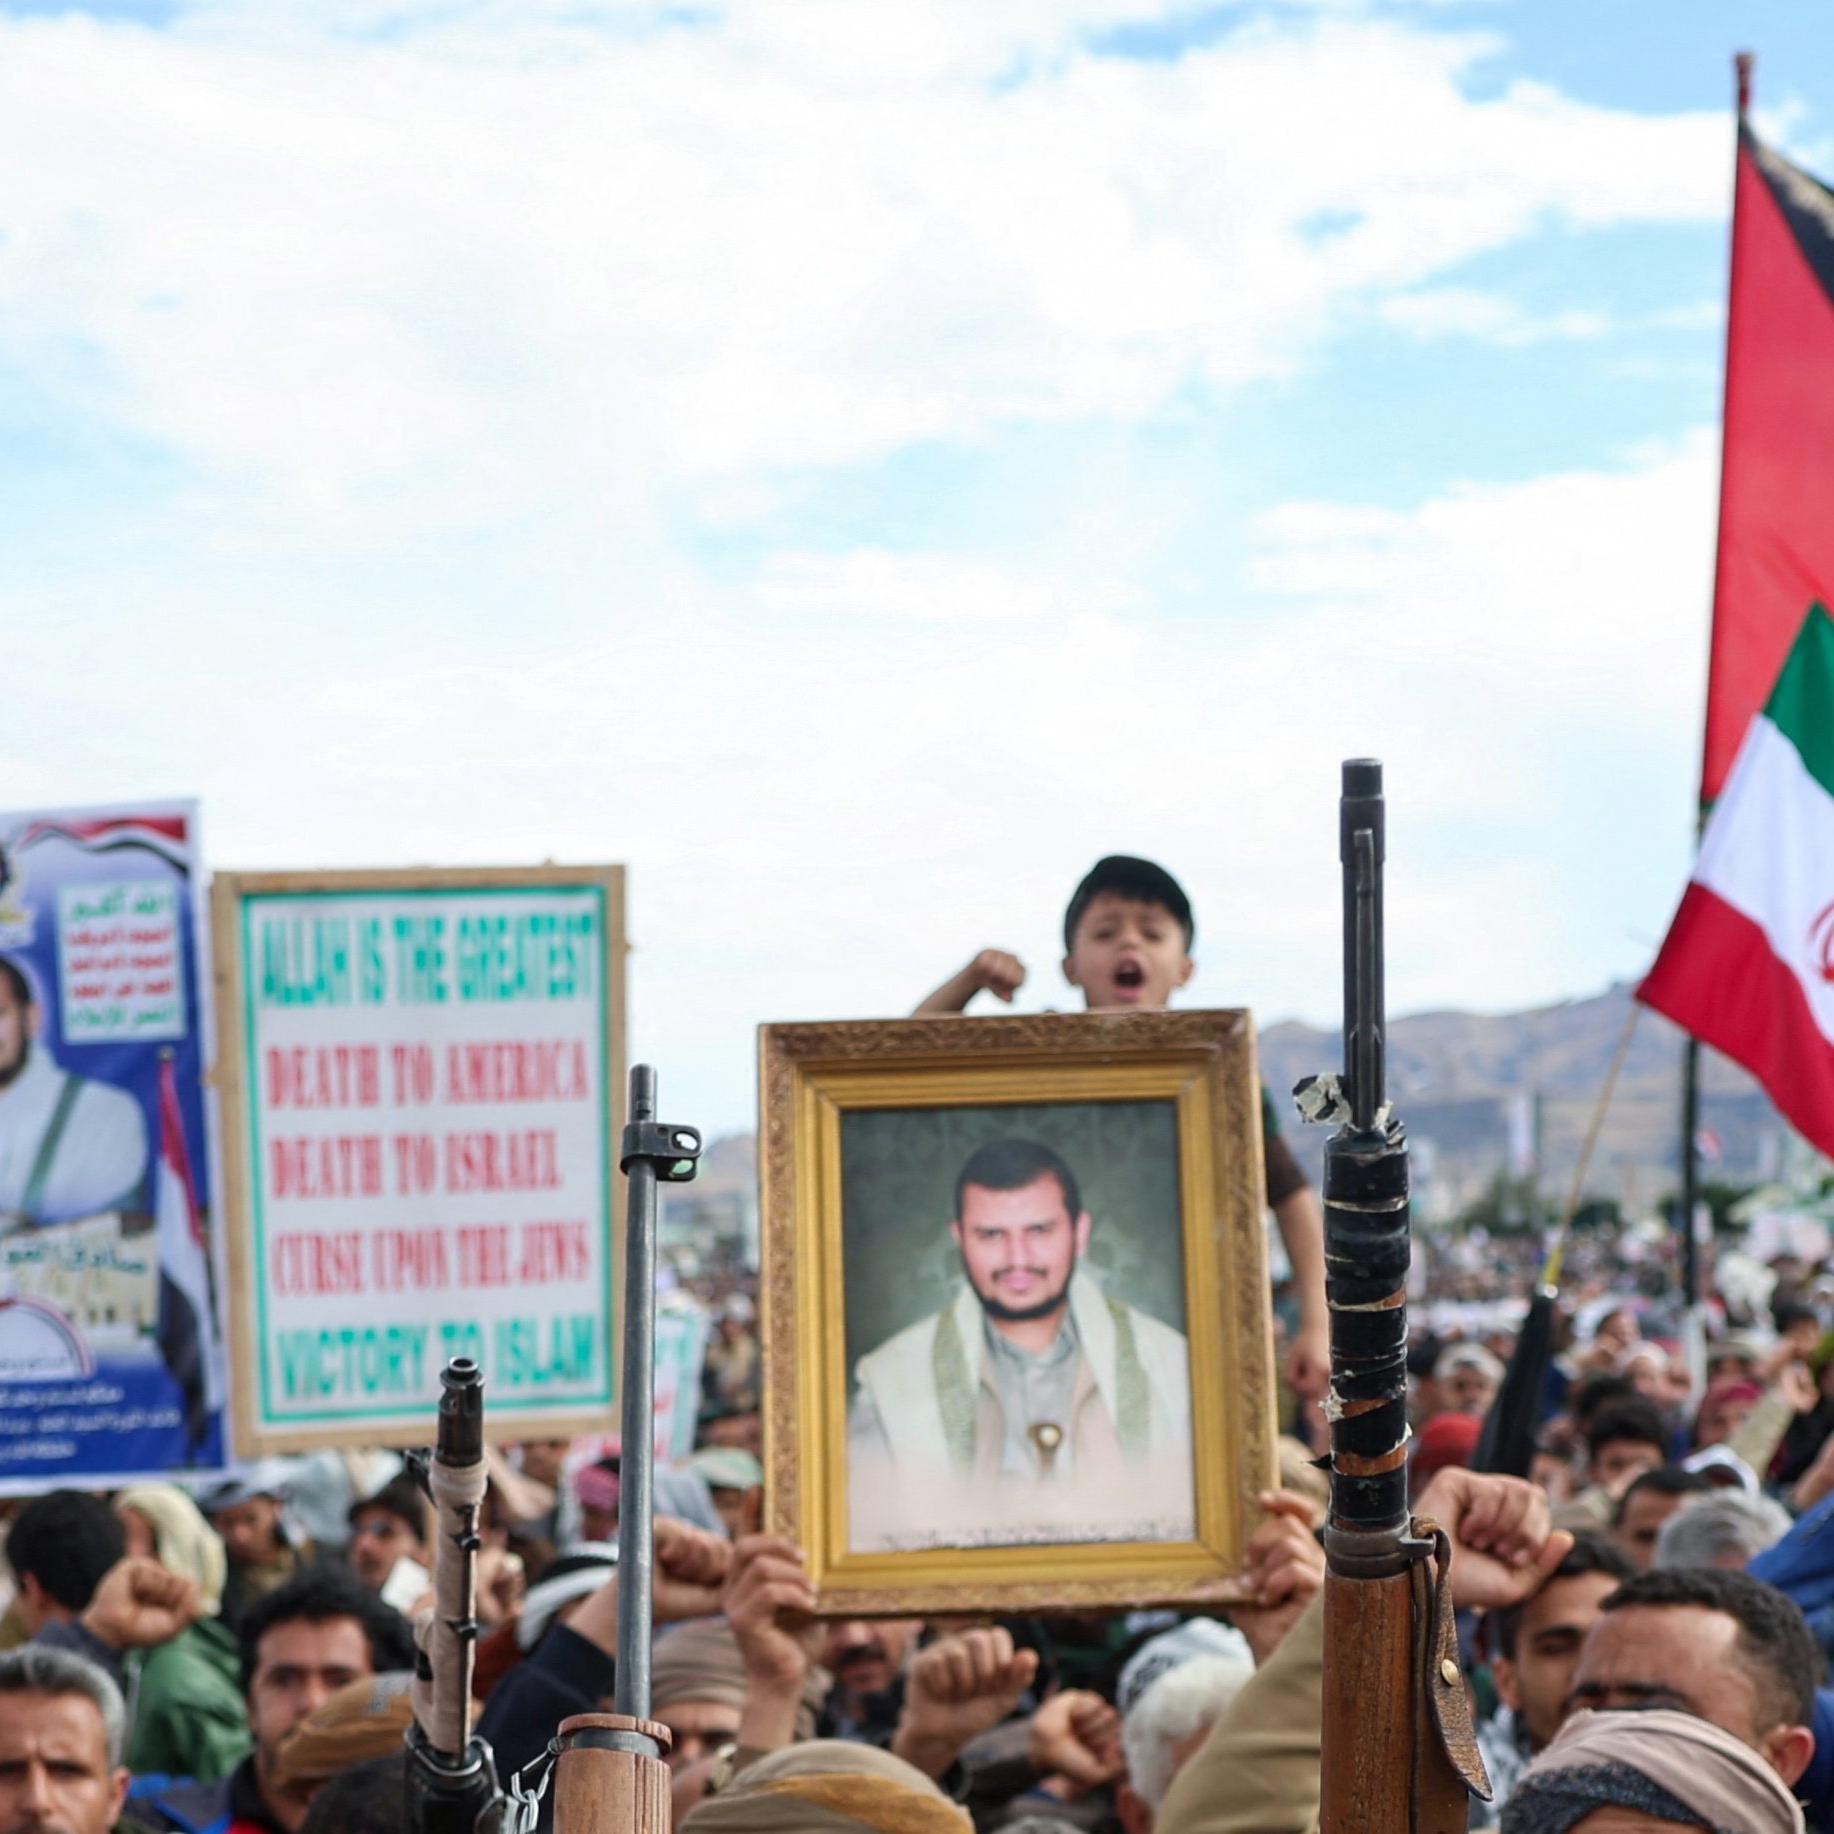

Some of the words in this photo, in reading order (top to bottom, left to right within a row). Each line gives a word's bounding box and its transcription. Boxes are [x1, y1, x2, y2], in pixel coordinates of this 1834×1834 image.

[261, 920, 347, 1003] ALLAH
[361, 918, 383, 1002] IS
[396, 917, 447, 1001] THE
[460, 915, 593, 1000] GREATEST
[268, 1043, 377, 1106] DEATH
[393, 1043, 433, 1104] TO
[449, 1040, 589, 1101] AMERICA
[273, 1136, 381, 1196] DEATH
[396, 1135, 436, 1194] TO
[445, 1131, 561, 1191] ISRAEL
[274, 1233, 363, 1295] CURSE
[374, 1230, 448, 1292] UPON
[459, 1226, 509, 1285] THE
[520, 1222, 591, 1283] JEWS
[277, 1327, 427, 1396] VICTORY
[496, 1318, 594, 1386] ISLAM
